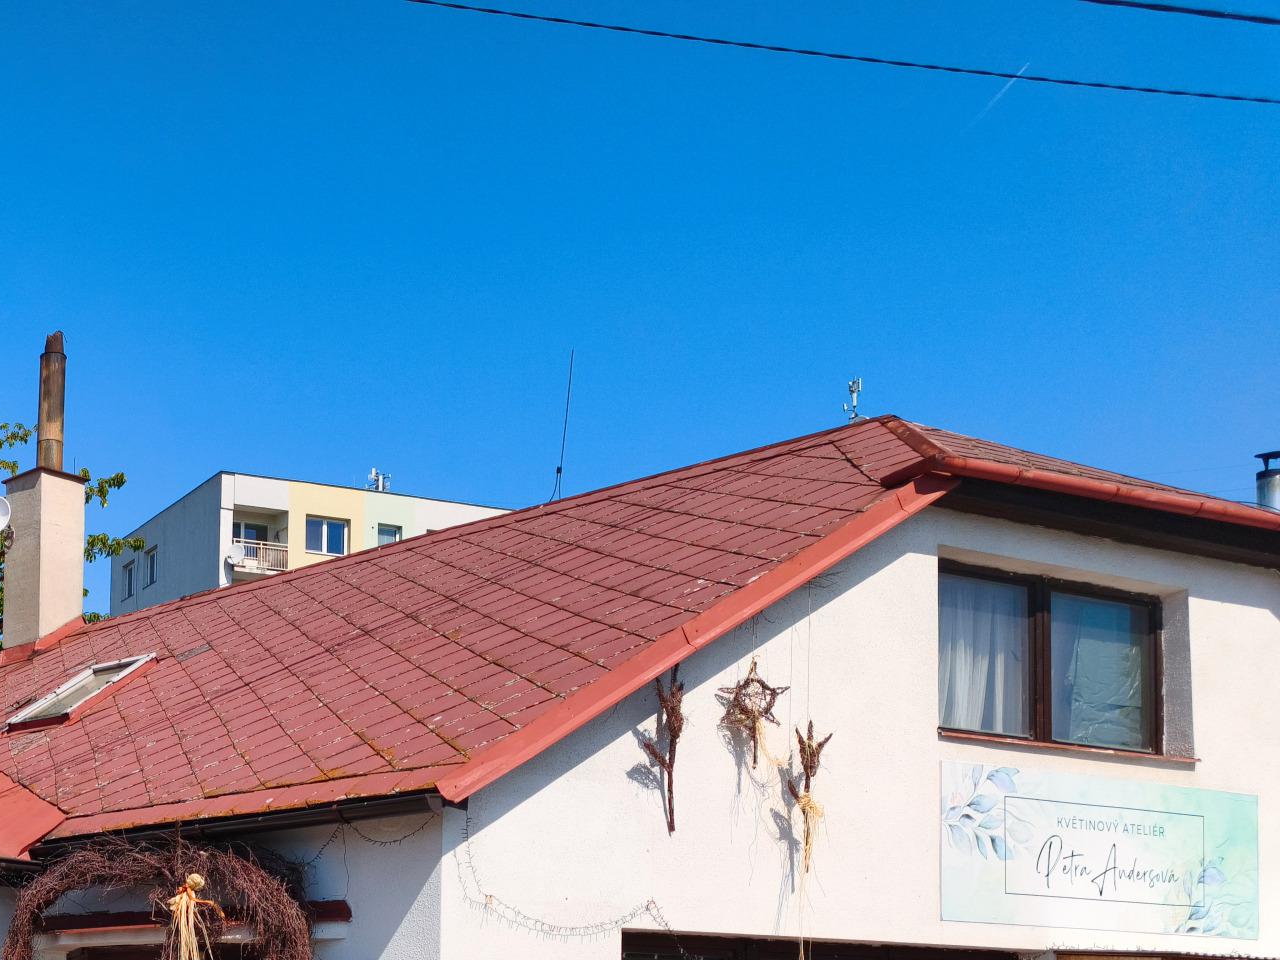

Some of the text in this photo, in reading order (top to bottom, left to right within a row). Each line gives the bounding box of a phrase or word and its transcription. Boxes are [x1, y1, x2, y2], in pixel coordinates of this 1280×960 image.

[1056, 816, 1166, 837] KVĚTINOVÝ ATELIÉR
[1036, 834, 1179, 896] Petra Andersová
